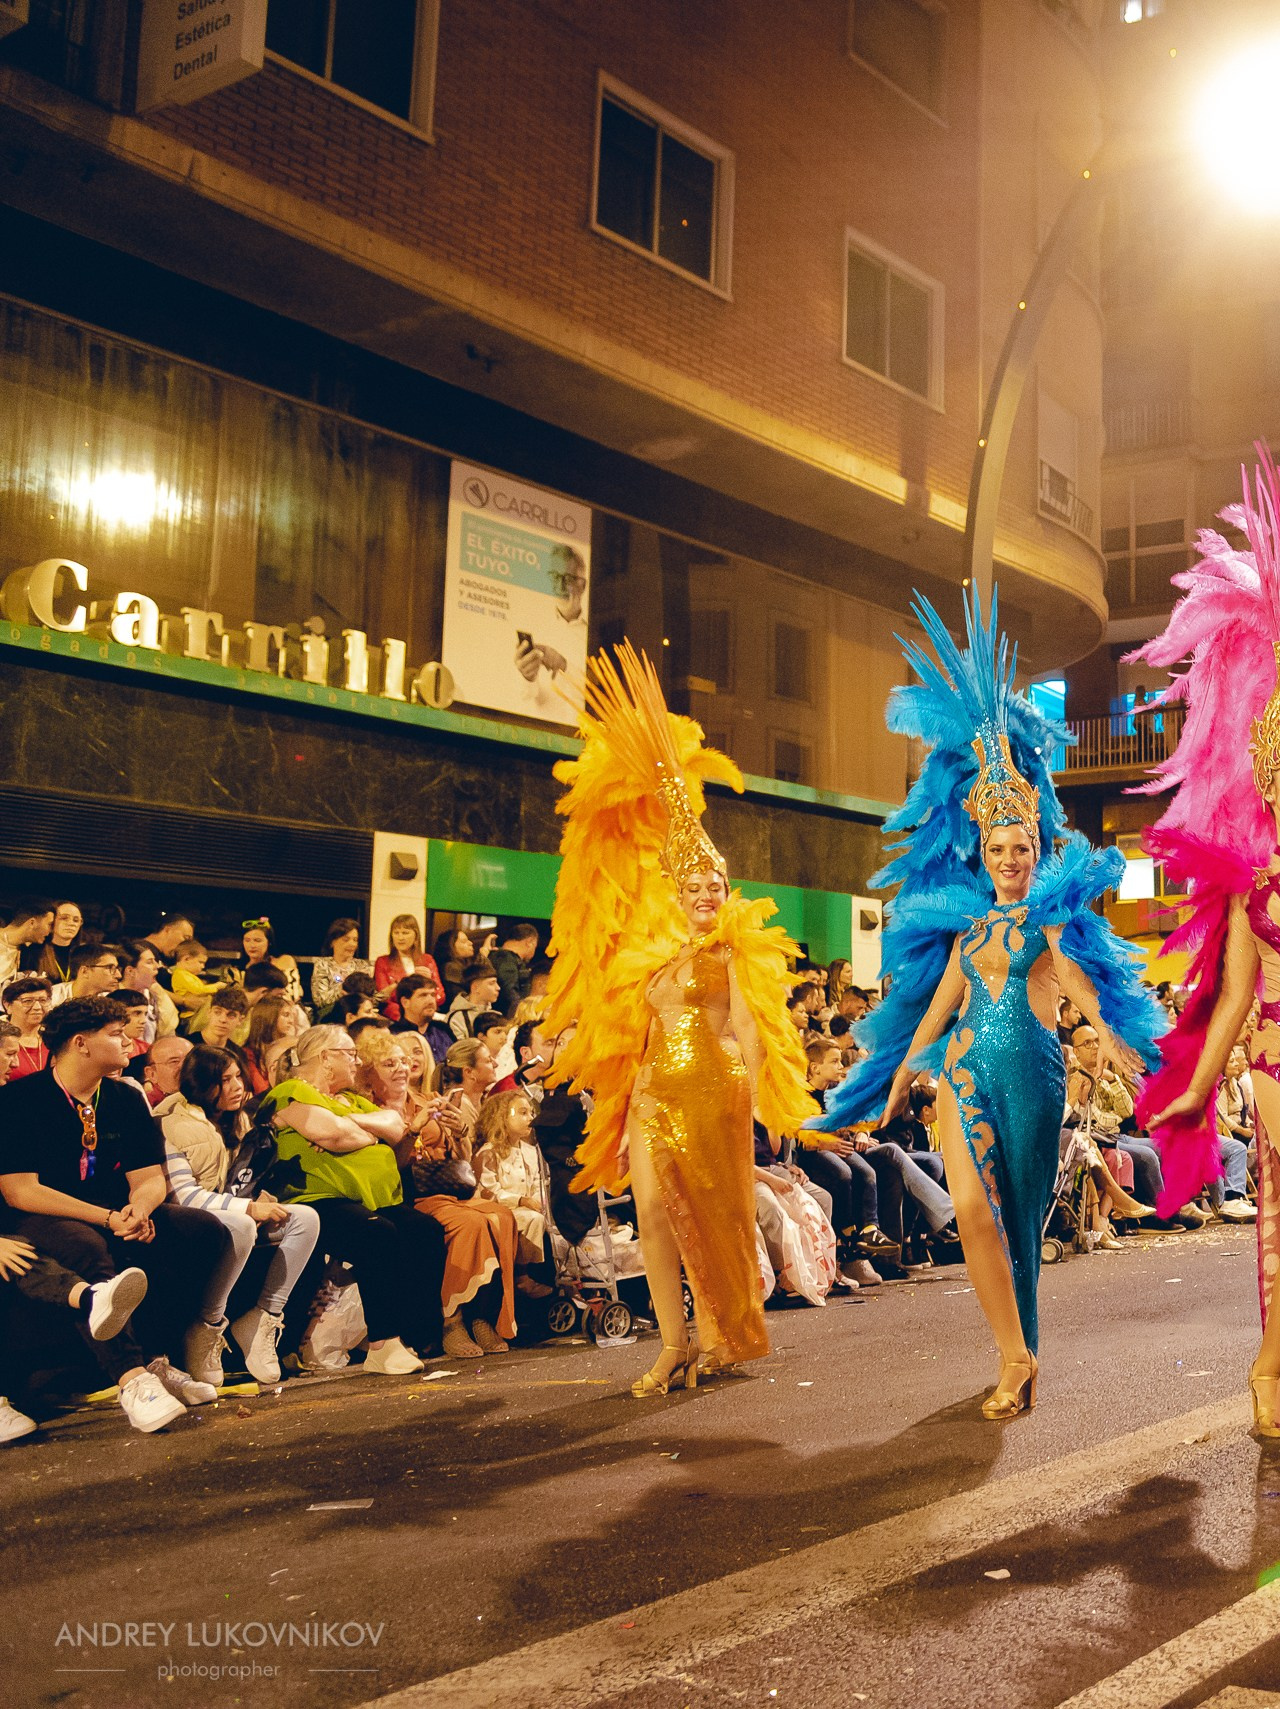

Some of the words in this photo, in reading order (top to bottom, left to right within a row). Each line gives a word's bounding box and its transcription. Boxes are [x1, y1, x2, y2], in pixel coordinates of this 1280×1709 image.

[175, 13, 231, 50] Estética
[173, 44, 218, 81] Dental
[492, 491, 577, 534] CARRILLO
[467, 532, 486, 551] EL
[28, 558, 456, 709] Carrillo
